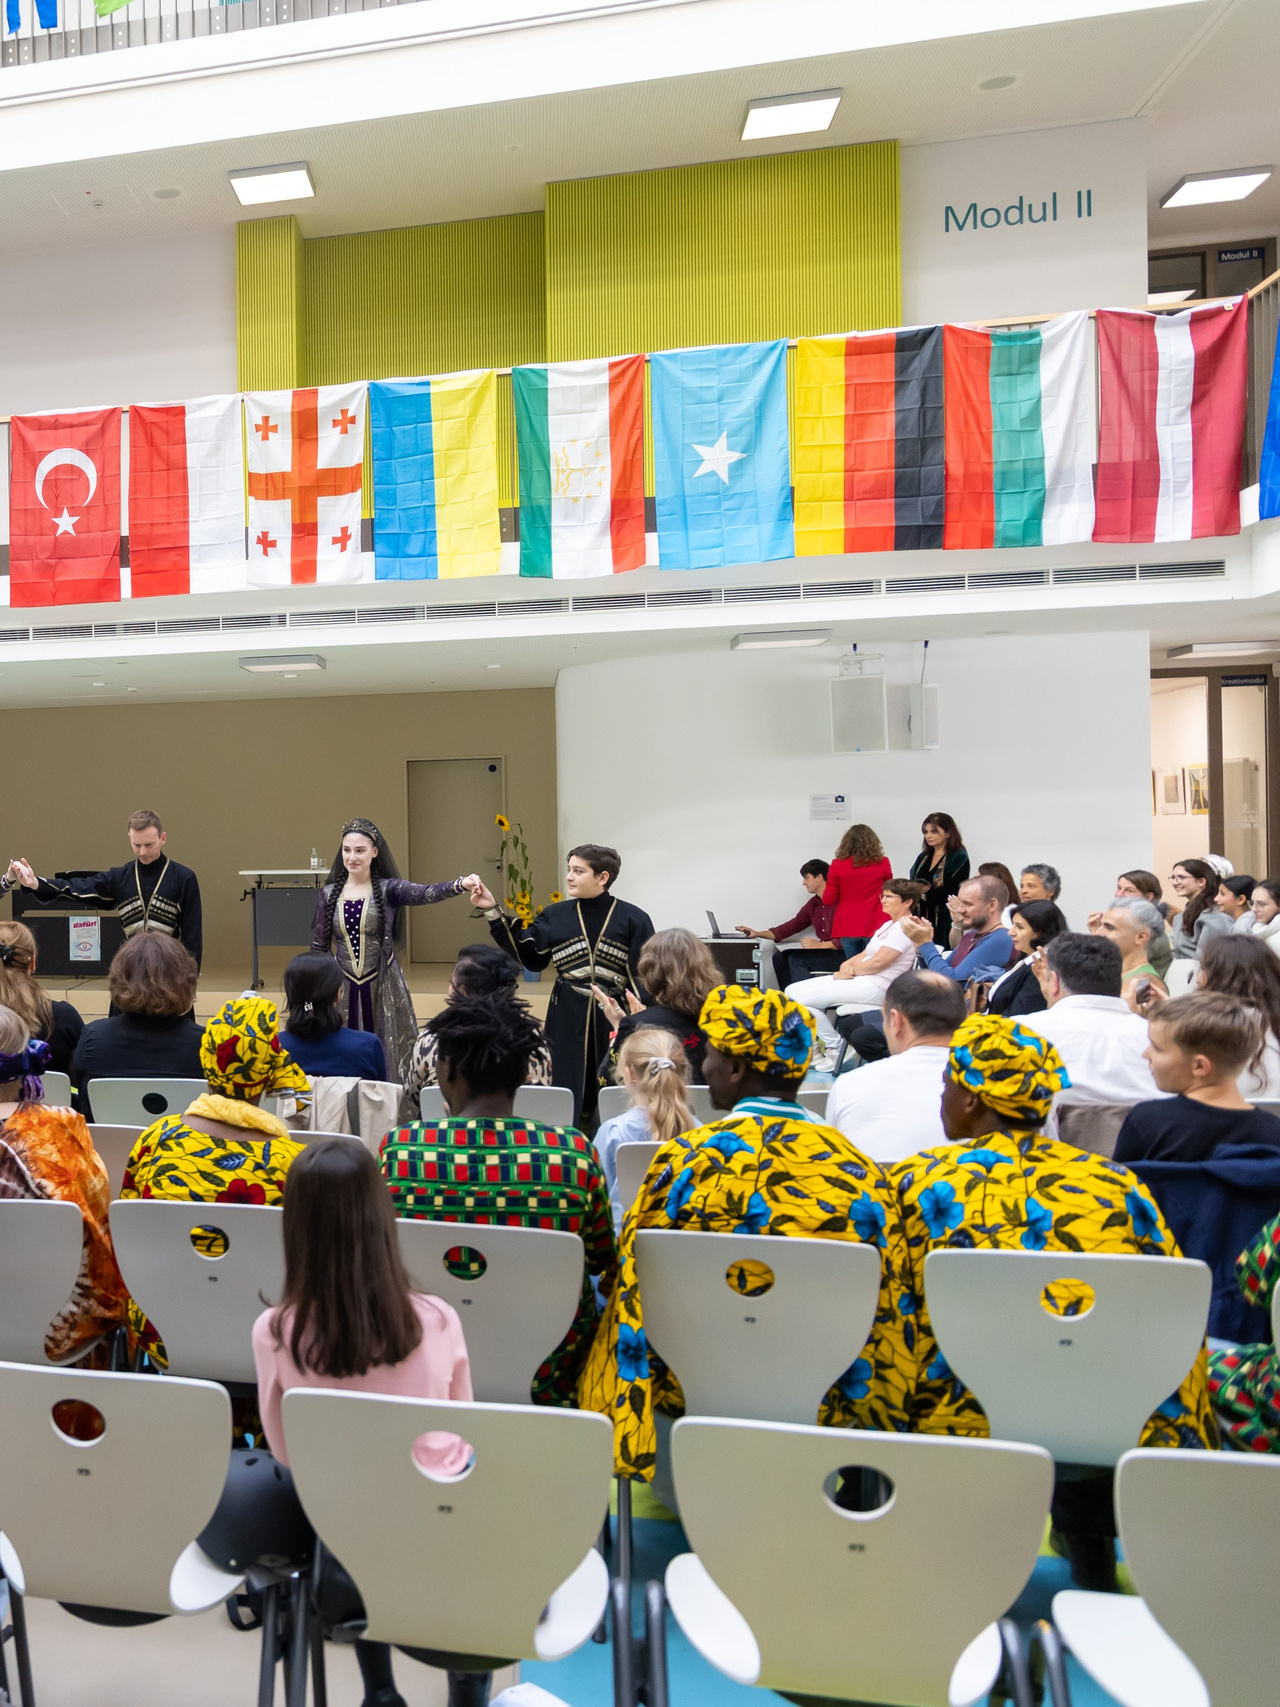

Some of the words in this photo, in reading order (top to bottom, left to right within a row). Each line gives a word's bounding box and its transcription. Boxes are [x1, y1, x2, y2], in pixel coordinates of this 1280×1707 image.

[943, 191, 1058, 233] Modul
[1076, 189, 1093, 218] II
[1221, 251, 1250, 260] Modul
